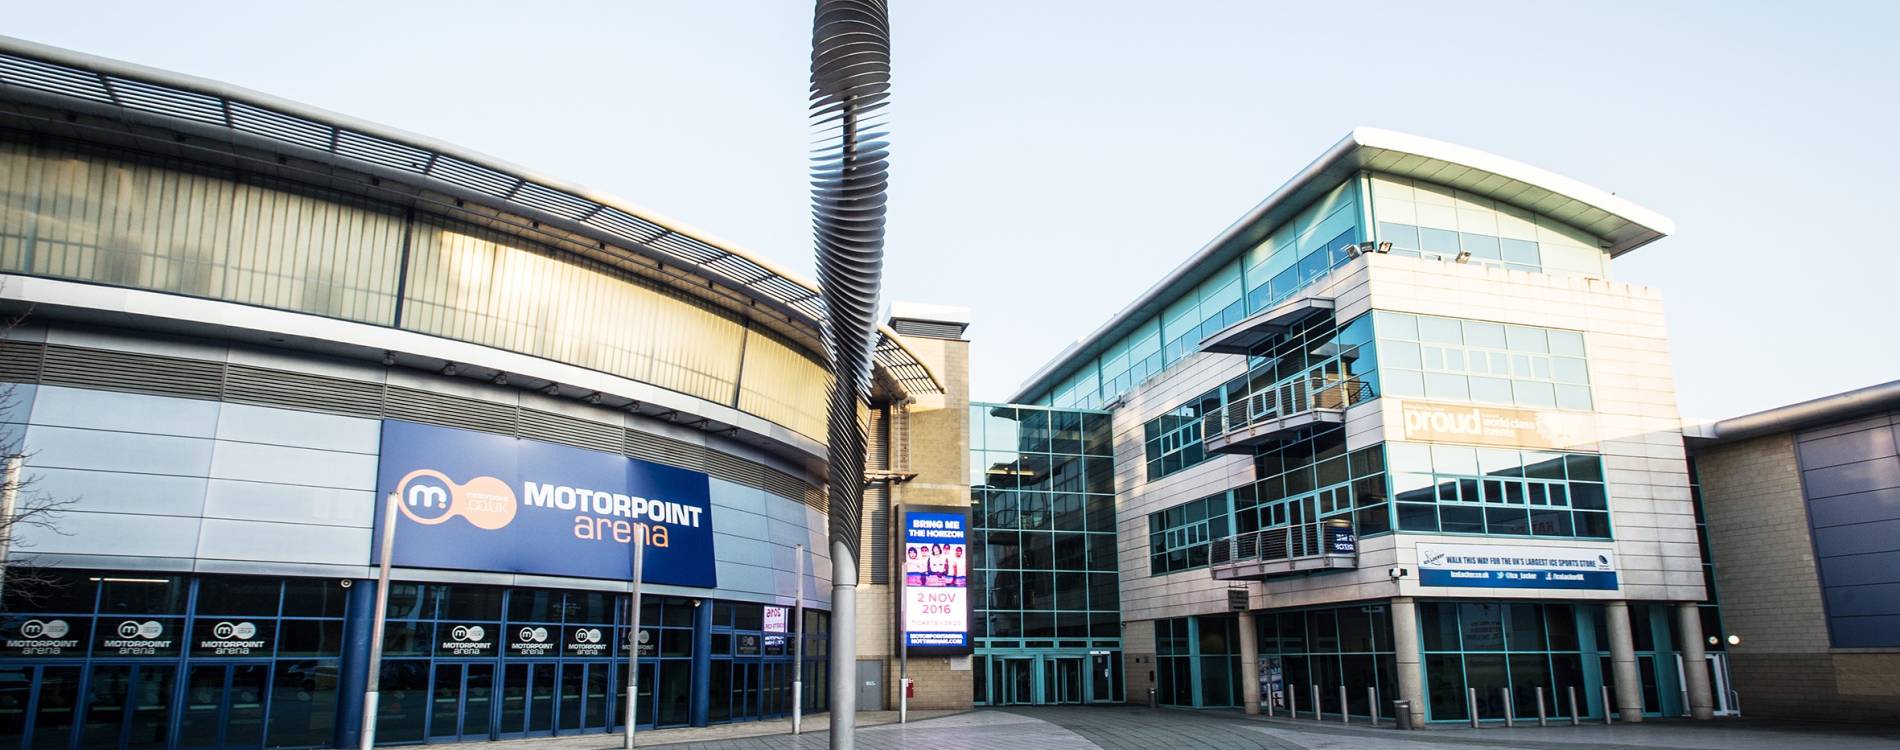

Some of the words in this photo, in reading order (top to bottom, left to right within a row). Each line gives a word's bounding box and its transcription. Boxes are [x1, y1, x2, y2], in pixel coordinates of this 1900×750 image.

[1405, 408, 1481, 436] proud
[524, 481, 702, 528] MOTORPOINT
[913, 520, 943, 529] BRING
[945, 521, 959, 529] ME
[574, 514, 668, 548] arena
[909, 529, 925, 537] THE
[927, 530, 964, 538] HORIZON
[1446, 556, 1462, 564] WALK
[1490, 557, 1500, 565] FOR
[1526, 558, 1547, 566] LARGEST
[1580, 560, 1596, 568] STORE
[917, 593, 924, 602] 2
[929, 593, 956, 603] NOV
[922, 604, 951, 614] 2016
[104, 640, 172, 648] MOTORPOINT
[201, 640, 264, 648] MOTORPOINT
[22, 647, 61, 655] arena
[119, 647, 155, 655] arena
[215, 647, 249, 655] arena
